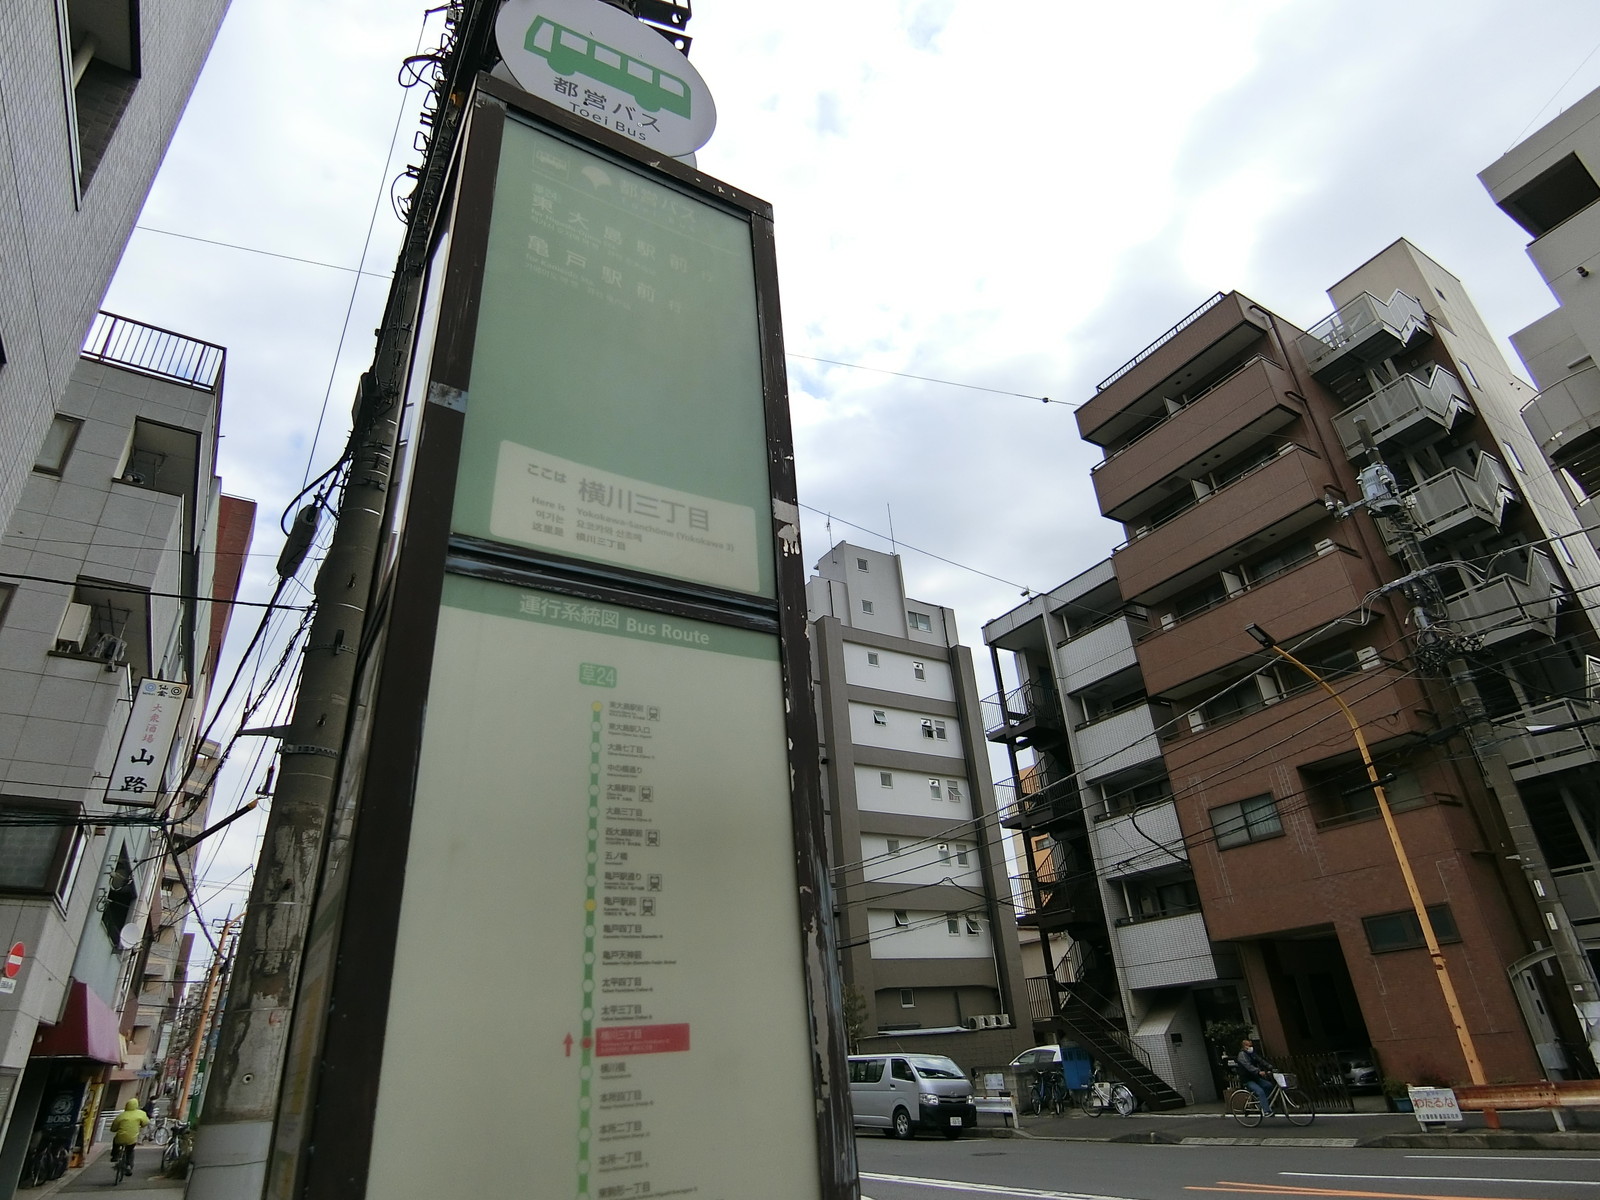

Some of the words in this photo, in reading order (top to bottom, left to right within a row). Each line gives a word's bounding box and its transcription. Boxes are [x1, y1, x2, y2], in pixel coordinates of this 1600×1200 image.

[552, 76, 661, 133] 都営バス
[569, 102, 609, 125] Toei
[615, 120, 647, 141] Bus
[526, 462, 568, 485] ここは
[578, 477, 709, 532] 横川三丁目
[531, 495, 556, 510] Here
[557, 501, 566, 512] is
[535, 509, 565, 525] 여기는
[519, 593, 621, 630] 運行系統図
[626, 617, 657, 636] Bus
[661, 623, 710, 646] Route
[581, 664, 615, 686] 草24
[141, 702, 163, 744] 大衆酒場
[120, 747, 156, 794] 山路
[46, 1114, 72, 1124] BOSS
[1412, 1096, 1455, 1109] わたるな
